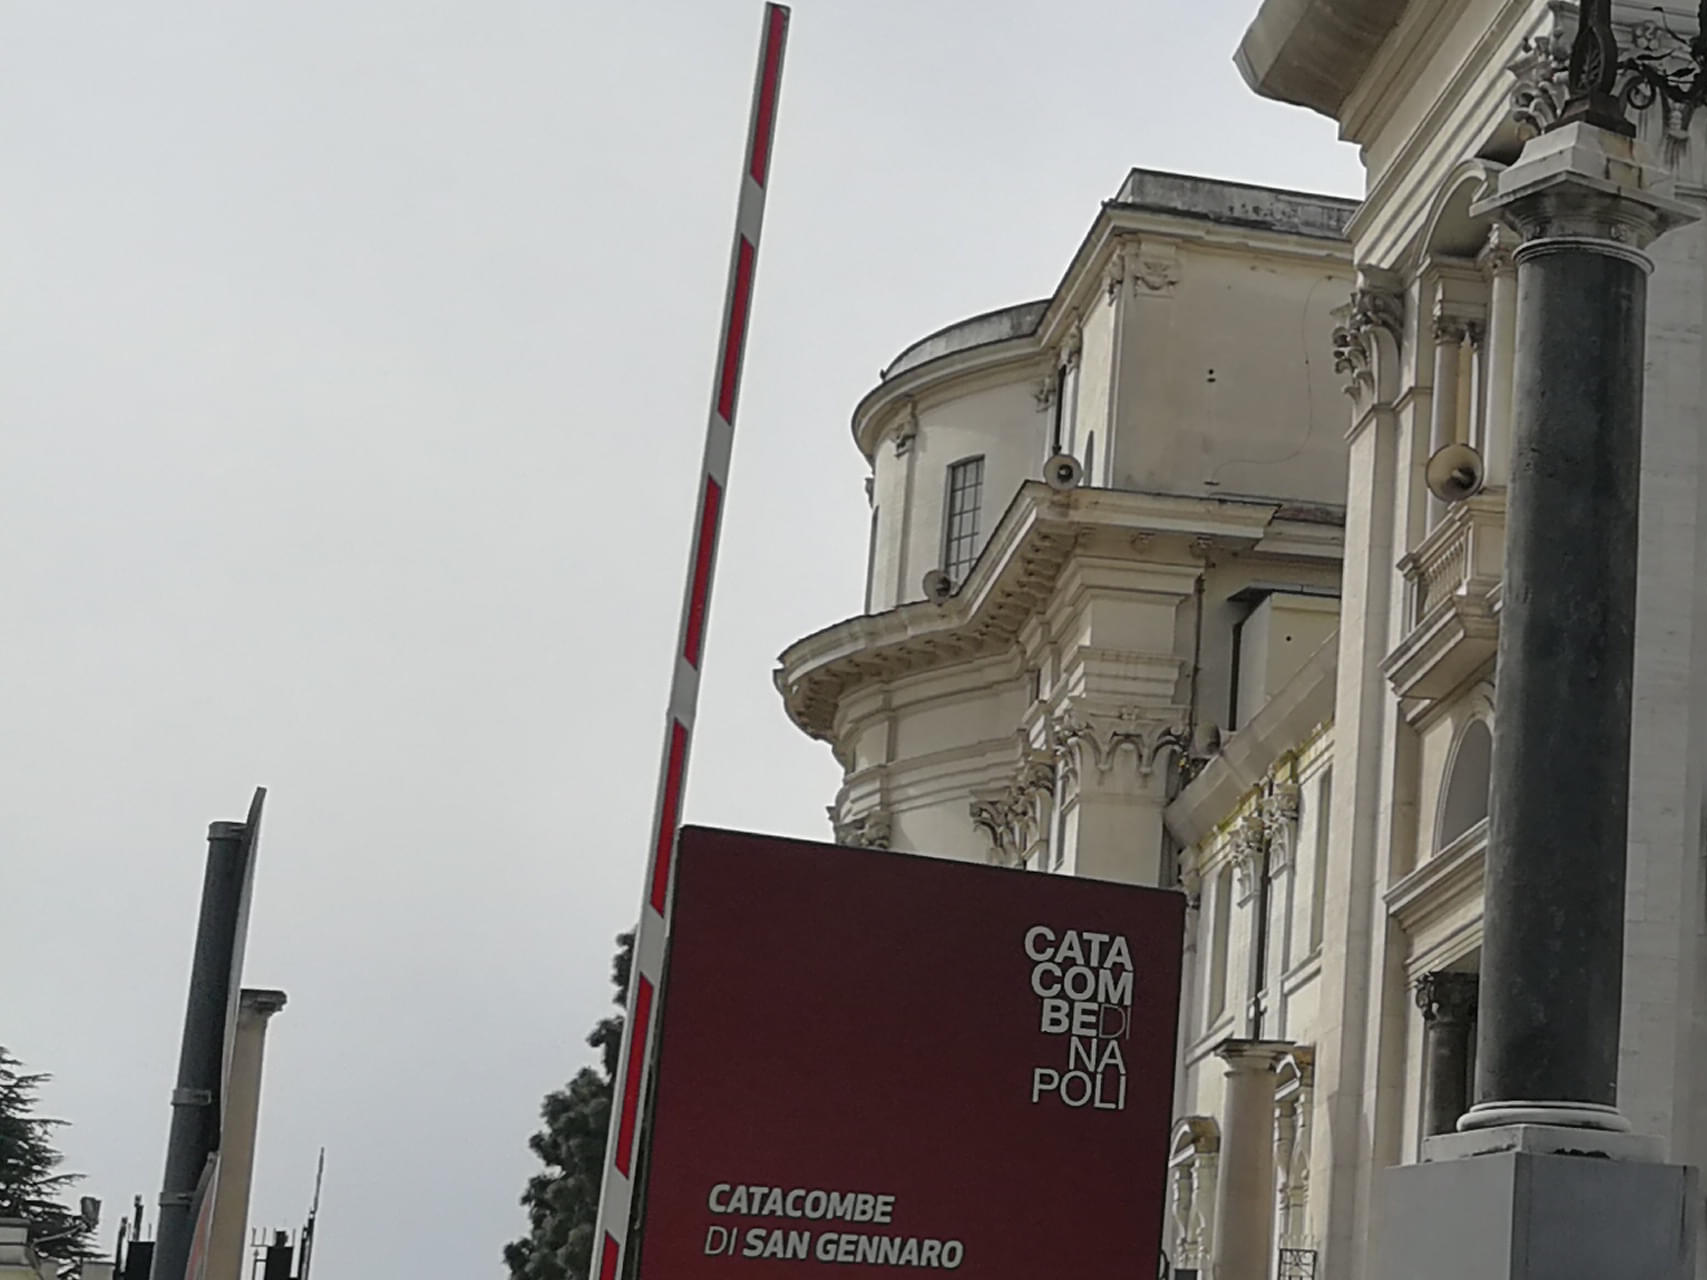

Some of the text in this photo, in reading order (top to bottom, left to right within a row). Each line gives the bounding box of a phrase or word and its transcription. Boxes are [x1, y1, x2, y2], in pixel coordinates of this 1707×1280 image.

[1024, 925, 1134, 971] CATA
[1031, 962, 1134, 1006] COM
[1069, 1036, 1127, 1075] NA
[1032, 1068, 1127, 1111] POLI
[708, 1183, 896, 1224] CATACOMBE
[704, 1225, 965, 1270] DI SAN GENNARO
